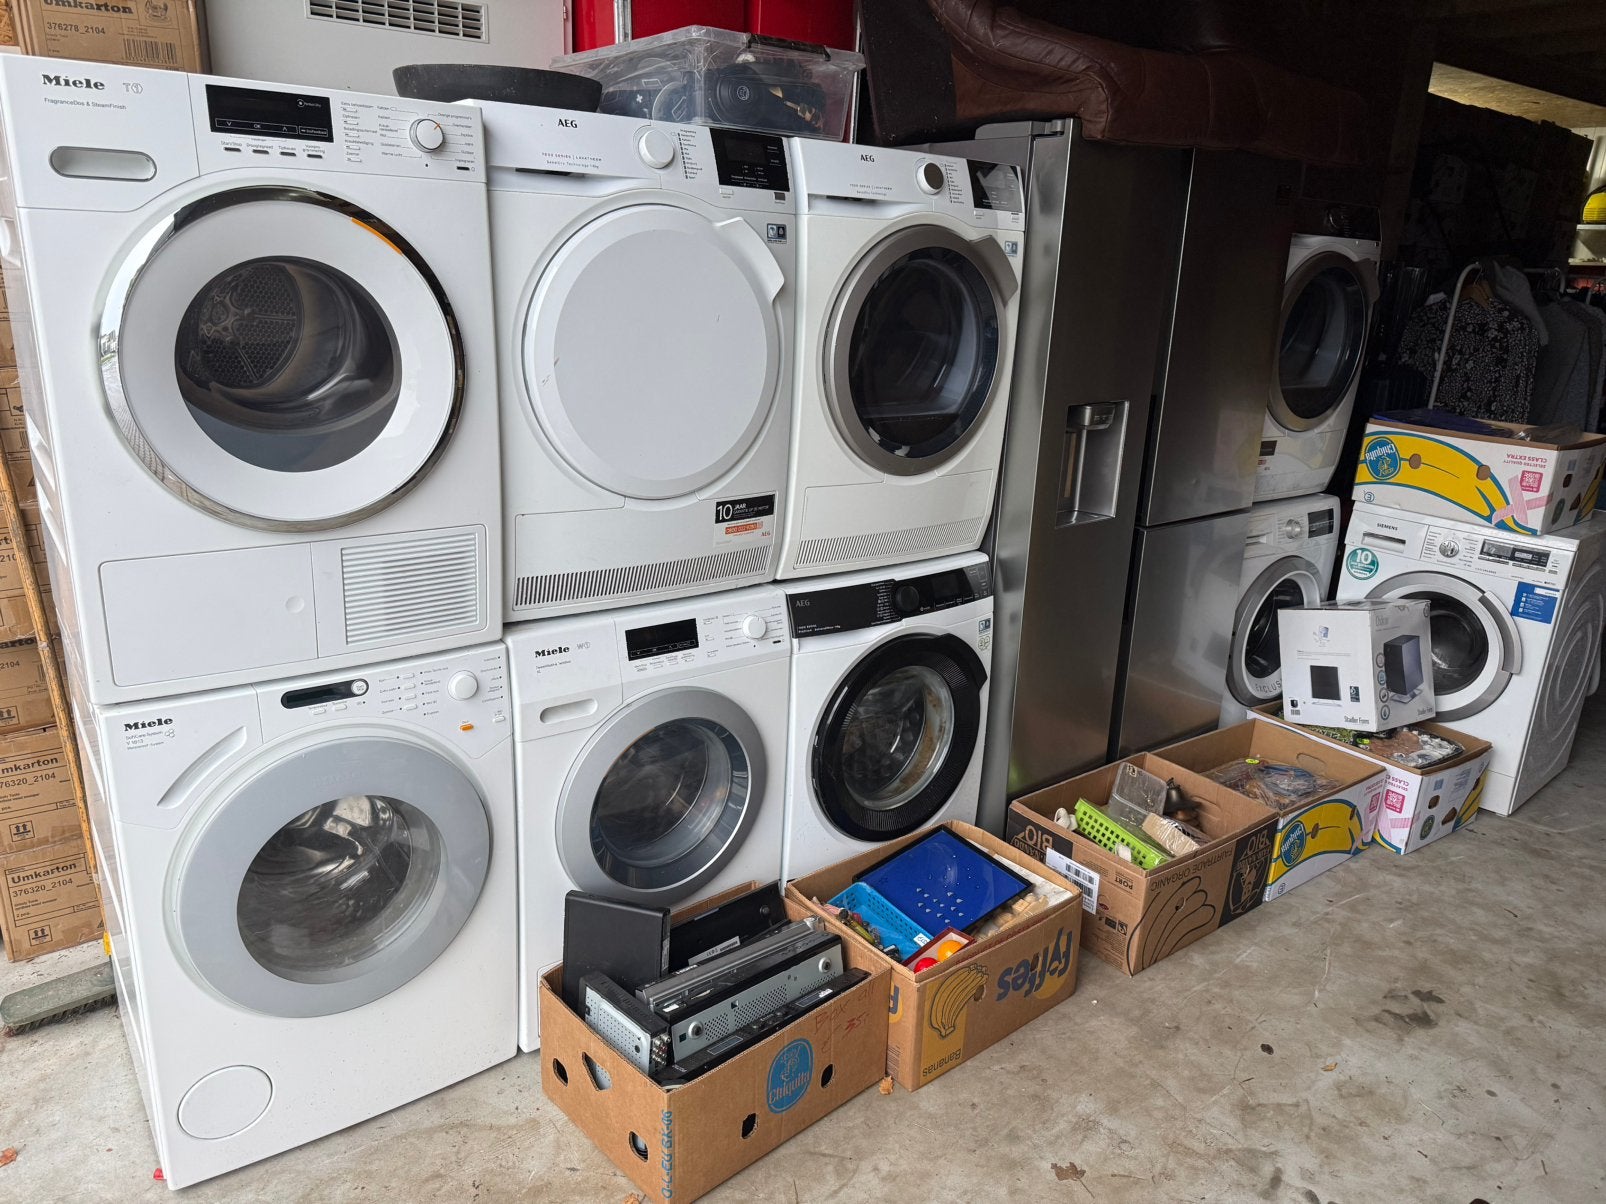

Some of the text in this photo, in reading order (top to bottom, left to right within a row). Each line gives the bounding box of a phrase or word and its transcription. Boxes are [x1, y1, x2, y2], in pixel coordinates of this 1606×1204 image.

[46, 21, 106, 35] 376278_2104
[41, 73, 105, 90] Miele
[91, 101, 127, 110] SteamFinish
[557, 118, 578, 128] AEG
[860, 154, 875, 163] AEG
[1365, 443, 1396, 461] Chiquita
[1527, 456, 1548, 464] CLASS
[717, 504, 733, 521] 10
[1376, 522, 1398, 531] SIEMENS
[1356, 549, 1373, 565] 10
[795, 599, 810, 607] AEG
[534, 646, 570, 658] Miele
[1255, 678, 1282, 693] EXCLUS
[124, 717, 174, 732] Miele
[1344, 715, 1370, 725] Stadler Form
[1025, 825, 1053, 852] BIO
[1247, 829, 1268, 855] BIO
[1281, 823, 1304, 853] Chiquita
[11, 862, 77, 884] Umkarton
[1150, 848, 1233, 892] FAIRTRADE ORGANIC
[12, 877, 74, 898] 376320_2104
[1114, 876, 1133, 890] PORT
[995, 925, 1073, 1002] Fyffes
[922, 1048, 962, 1078] Bananas
[768, 1070, 810, 1104] Chiquita
